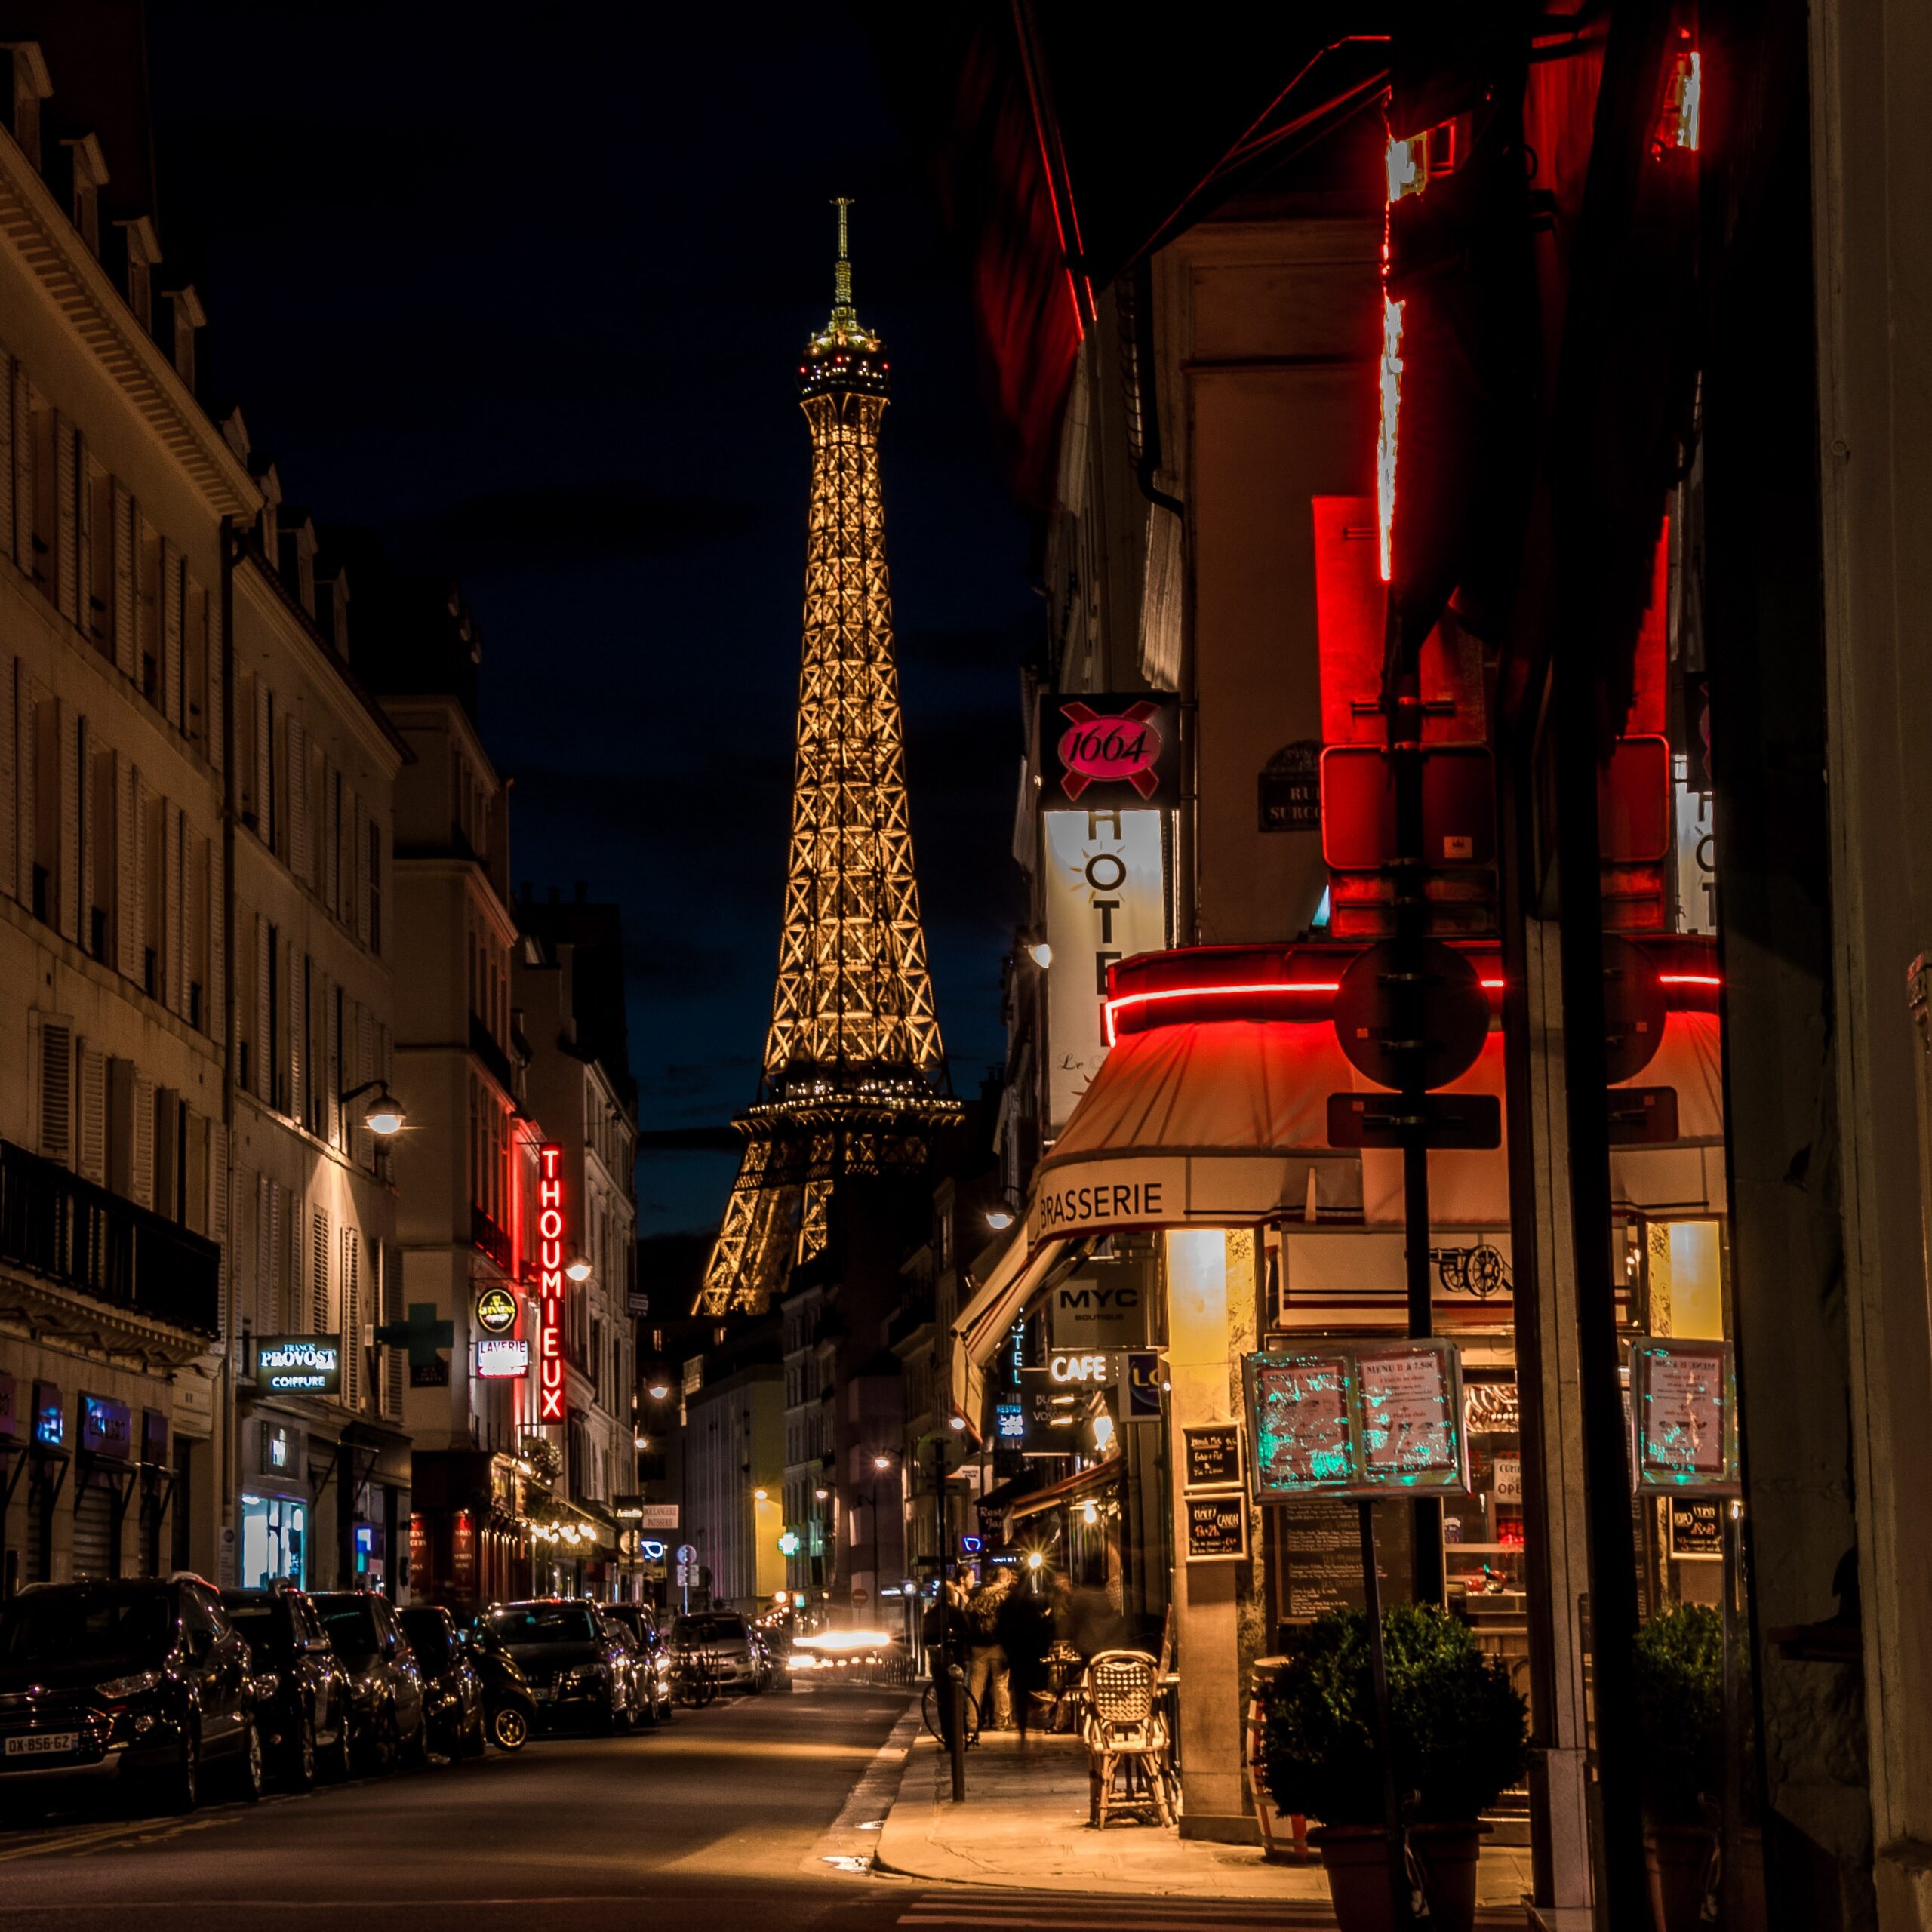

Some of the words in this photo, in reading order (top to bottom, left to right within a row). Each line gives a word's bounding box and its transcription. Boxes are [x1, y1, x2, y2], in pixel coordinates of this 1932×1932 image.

[1069, 724, 1152, 764] 1664
[1041, 1183, 1163, 1229] BRASSERIE
[540, 1149, 562, 1417] THOUMIEUX
[1060, 1288, 1138, 1308] MYC
[480, 1341, 526, 1353] LAVERIE
[260, 1349, 337, 1370] PROVOST
[1051, 1356, 1106, 1382] CAFE
[1367, 1364, 1394, 1374] MENU
[272, 1376, 325, 1387] COIFFURE
[9, 1736, 69, 1752] DX-856-GZ
